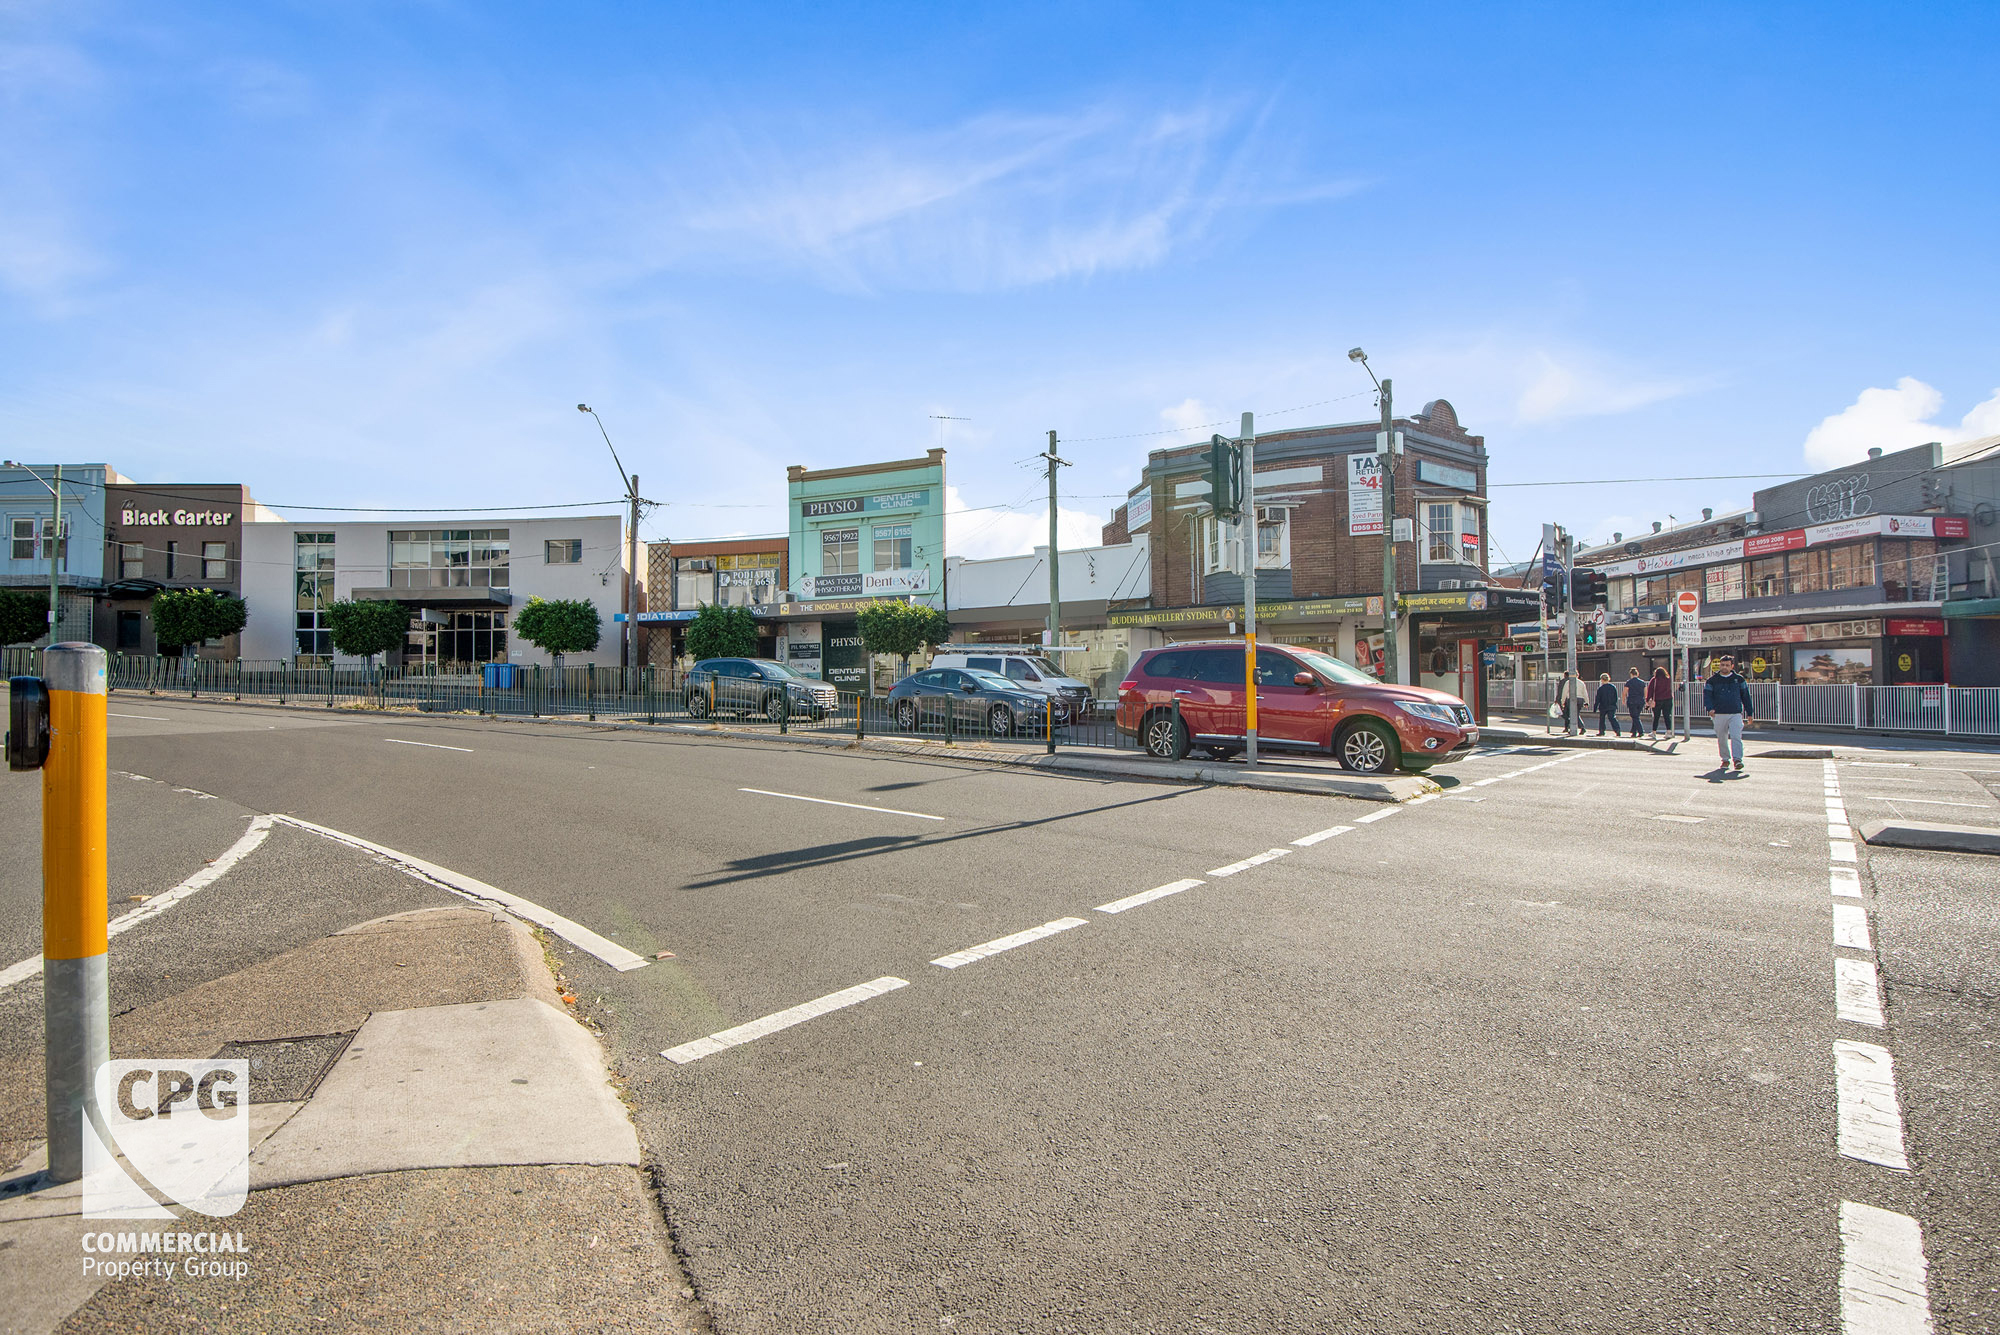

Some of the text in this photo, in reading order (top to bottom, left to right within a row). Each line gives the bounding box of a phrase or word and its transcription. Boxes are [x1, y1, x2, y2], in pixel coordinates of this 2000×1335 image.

[873, 492, 921, 503] DENTURE
[809, 500, 858, 515] PHYSIO
[880, 500, 913, 509] CLINIC
[122, 509, 232, 526] Black Garter
[824, 532, 858, 542] 9567 9922
[875, 529, 892, 538] 9567
[733, 570, 777, 580] PODIATRY
[815, 577, 861, 586] MIDAS TOUCH
[866, 576, 907, 588] Dentex
[815, 584, 862, 594] PHYSIOTHERAPY
[800, 604, 813, 612] THE
[814, 603, 840, 611] INCOME
[841, 602, 854, 610] TAX
[1239, 605, 1268, 614] NELESE
[1269, 604, 1288, 612] GOLD
[625, 612, 681, 621] PDIATRY
[1111, 610, 1218, 625] BUDDHA JEWELLERY SYDNEY
[830, 637, 864, 648] PHYSIO
[829, 667, 866, 675] DENTURE
